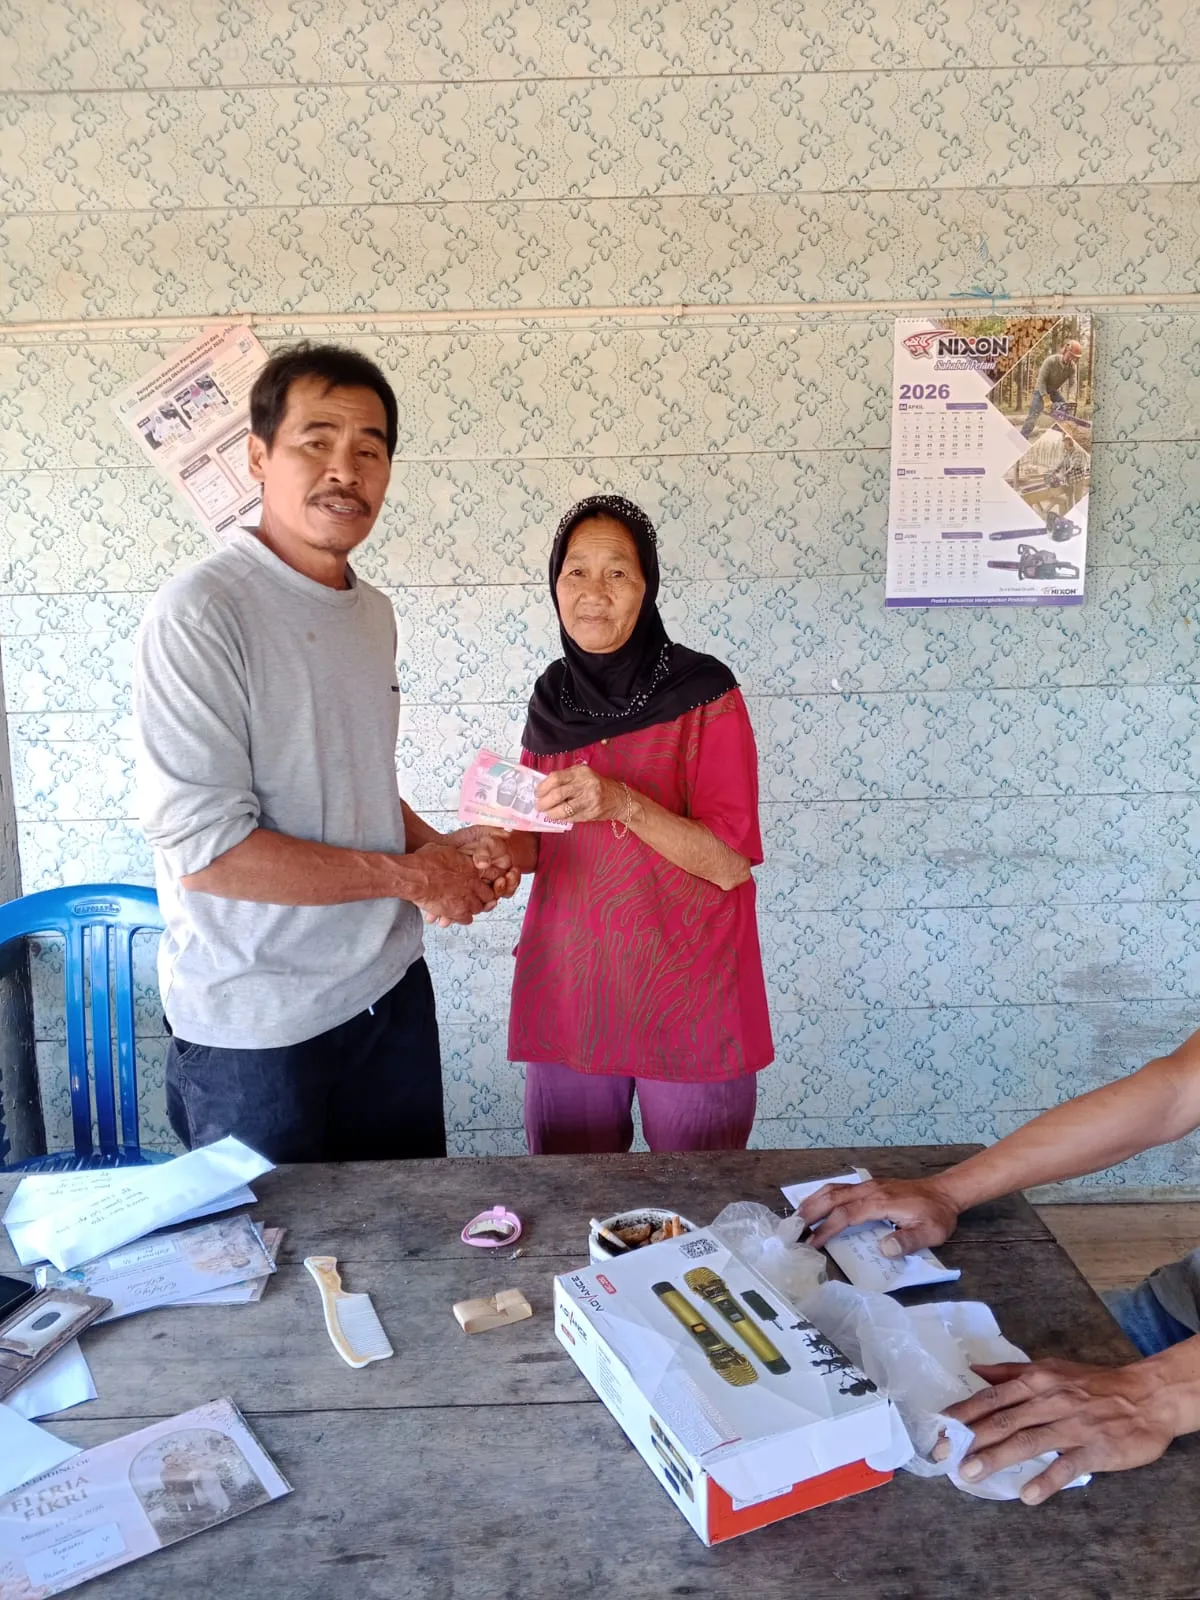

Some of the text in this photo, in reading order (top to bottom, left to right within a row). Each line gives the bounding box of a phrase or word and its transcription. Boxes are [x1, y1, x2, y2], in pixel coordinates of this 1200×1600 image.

[938, 337, 1007, 356] NIXON
[899, 383, 950, 400] 2026
[571, 1275, 604, 1312] ADVANCE
[24, 1489, 88, 1521] FIKRI
